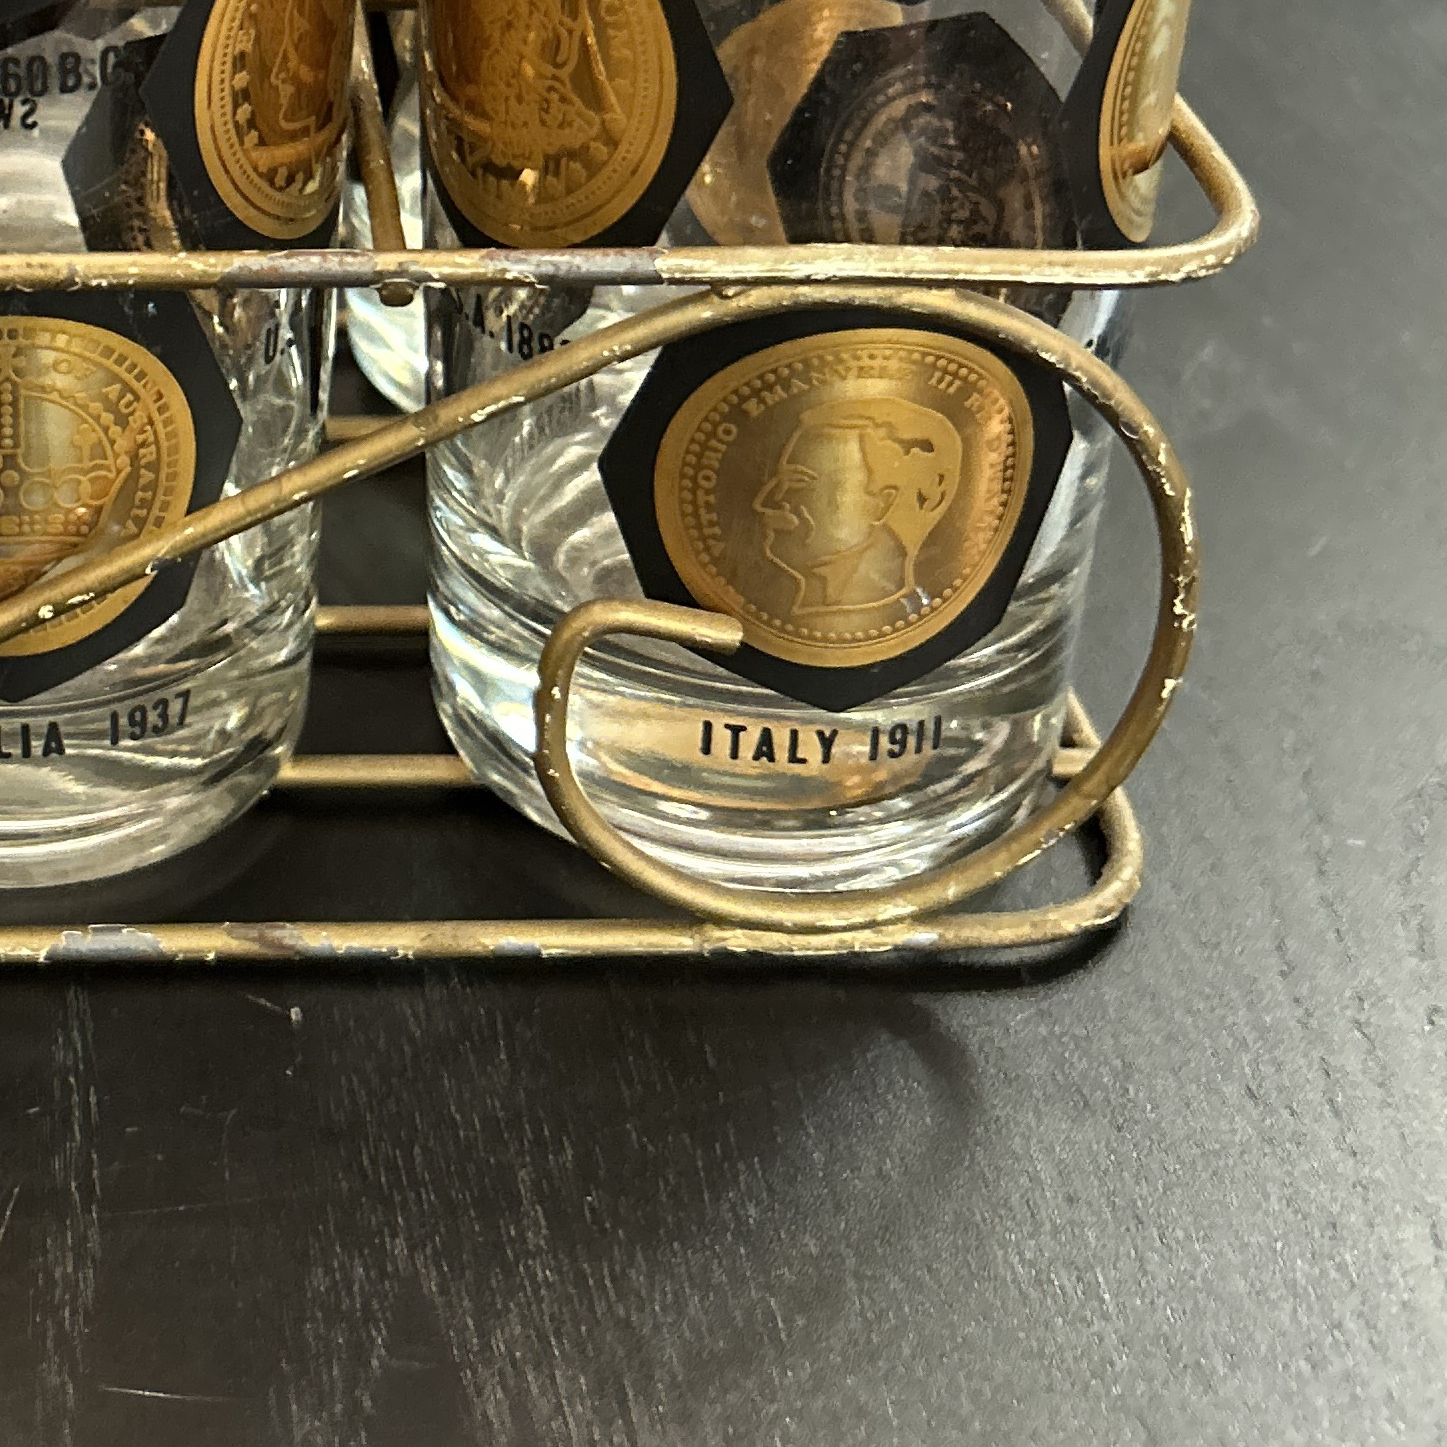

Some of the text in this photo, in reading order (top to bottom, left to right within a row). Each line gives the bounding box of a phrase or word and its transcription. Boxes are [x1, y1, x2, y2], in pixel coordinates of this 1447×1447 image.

[52, 355, 98, 381] OF
[109, 689, 192, 747] 1937
[700, 715, 944, 766] ITALY 1911
